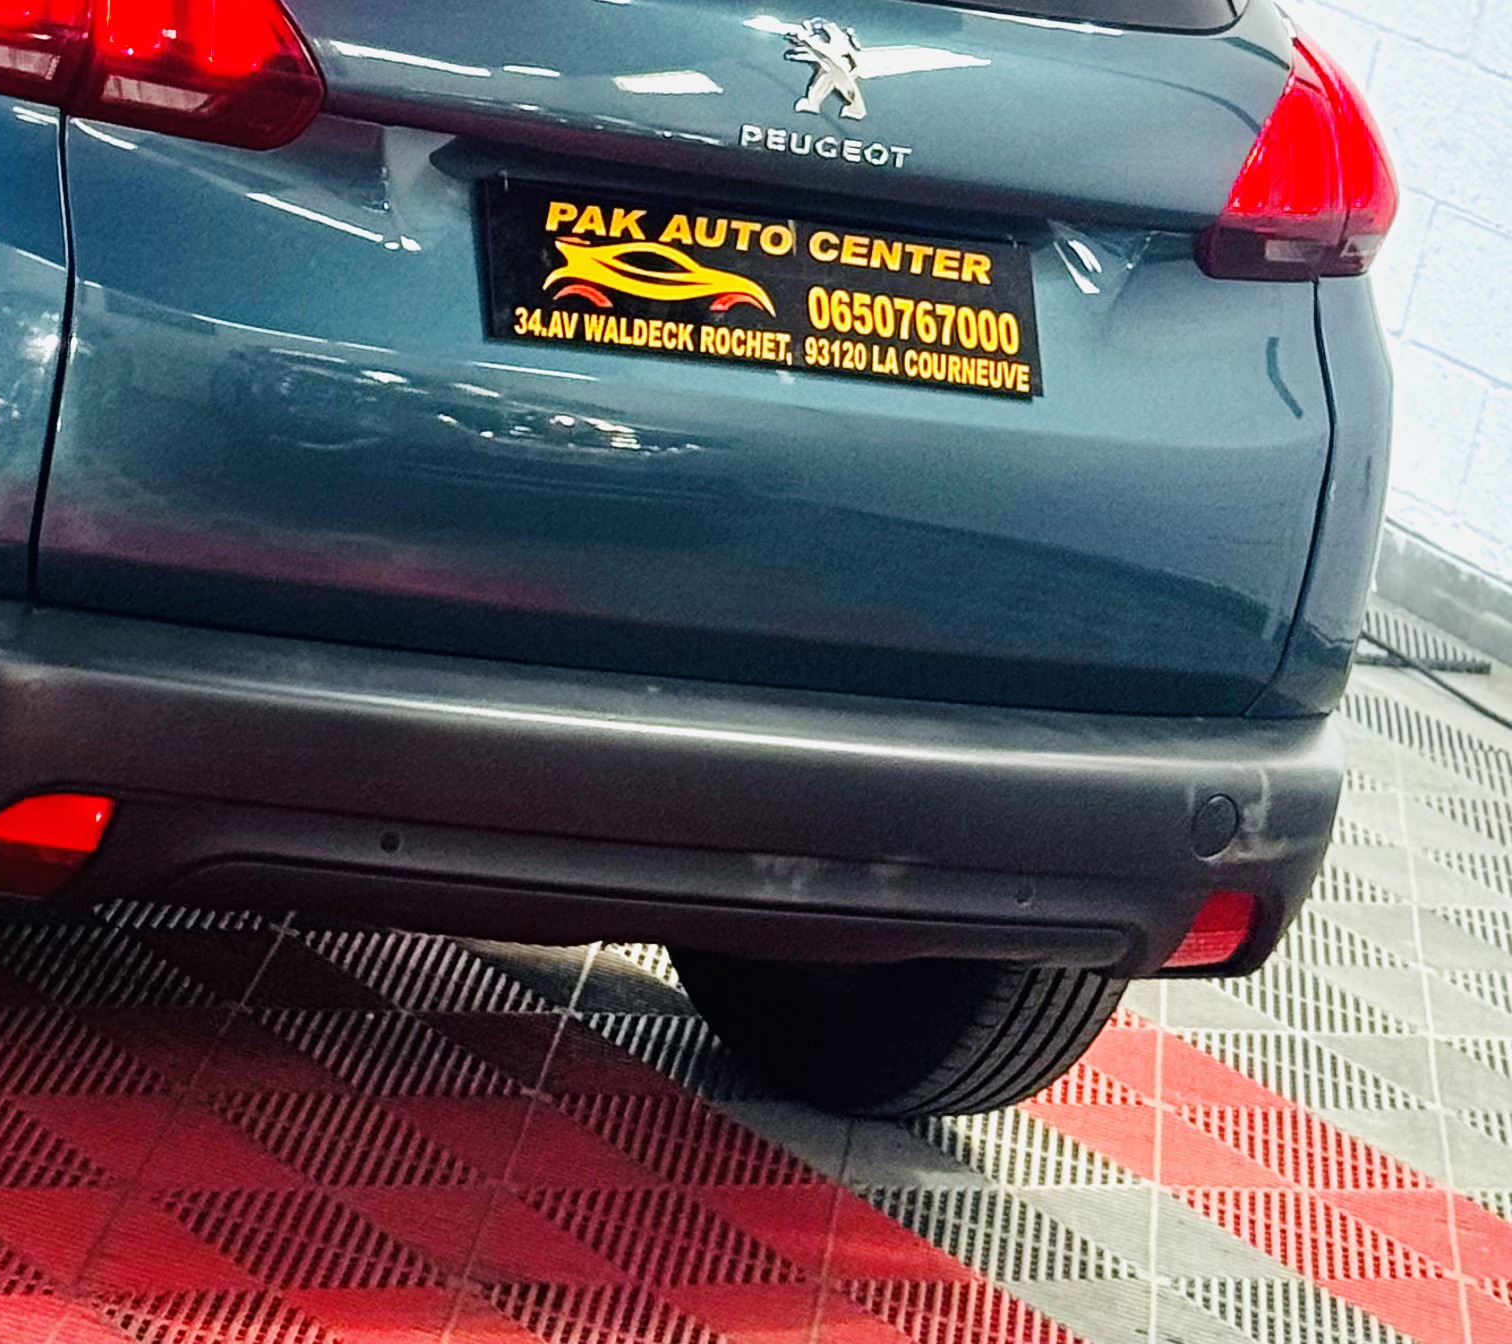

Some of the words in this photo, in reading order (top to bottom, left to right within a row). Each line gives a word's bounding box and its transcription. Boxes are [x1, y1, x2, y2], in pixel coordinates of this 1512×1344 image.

[740, 124, 913, 169] PEUGEOT
[545, 200, 647, 241] PAK
[659, 213, 794, 256] AUTO
[808, 230, 992, 286] CENTER
[583, 312, 694, 348] WALDECK
[699, 327, 794, 367] ROCHET,
[804, 336, 867, 371] 93120
[871, 344, 899, 376] LA
[903, 349, 1031, 394] COURNEUVE
[807, 285, 1019, 356] 0650767000
